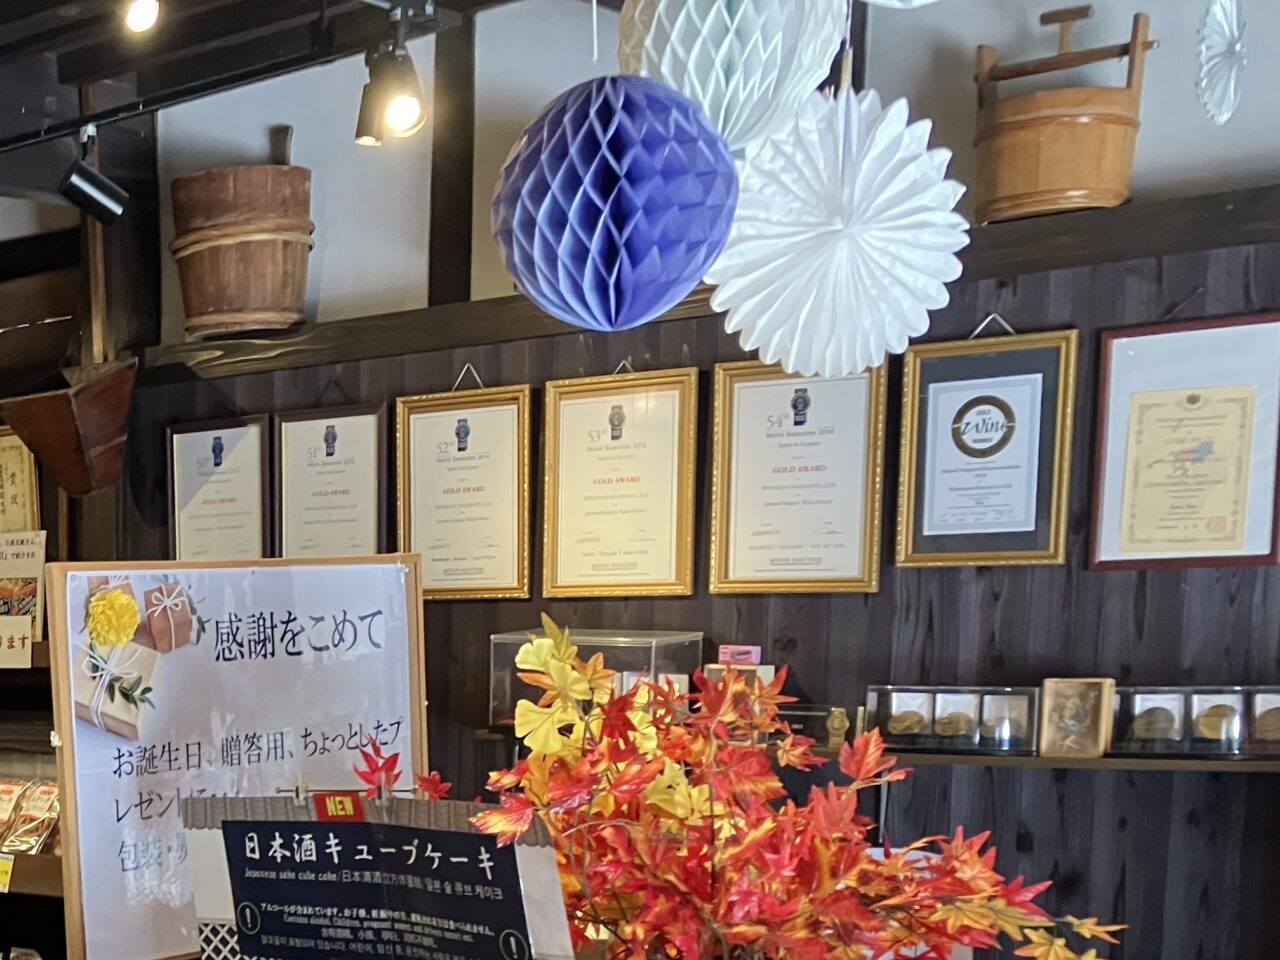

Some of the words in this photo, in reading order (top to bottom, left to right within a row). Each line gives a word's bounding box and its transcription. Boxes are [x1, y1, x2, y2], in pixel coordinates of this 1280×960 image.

[772, 466, 796, 475] GOLD
[213, 608, 385, 663] 感謝をこめて
[111, 715, 405, 779] お誕生日、贈答用、ちょっとしたプ
[325, 796, 356, 817] NEW
[243, 831, 496, 881] 日本酒キューブケーキ
[244, 867, 277, 880] Japanese
[279, 869, 296, 881] sake
[297, 869, 316, 881] cube
[475, 884, 504, 900] 케이크
